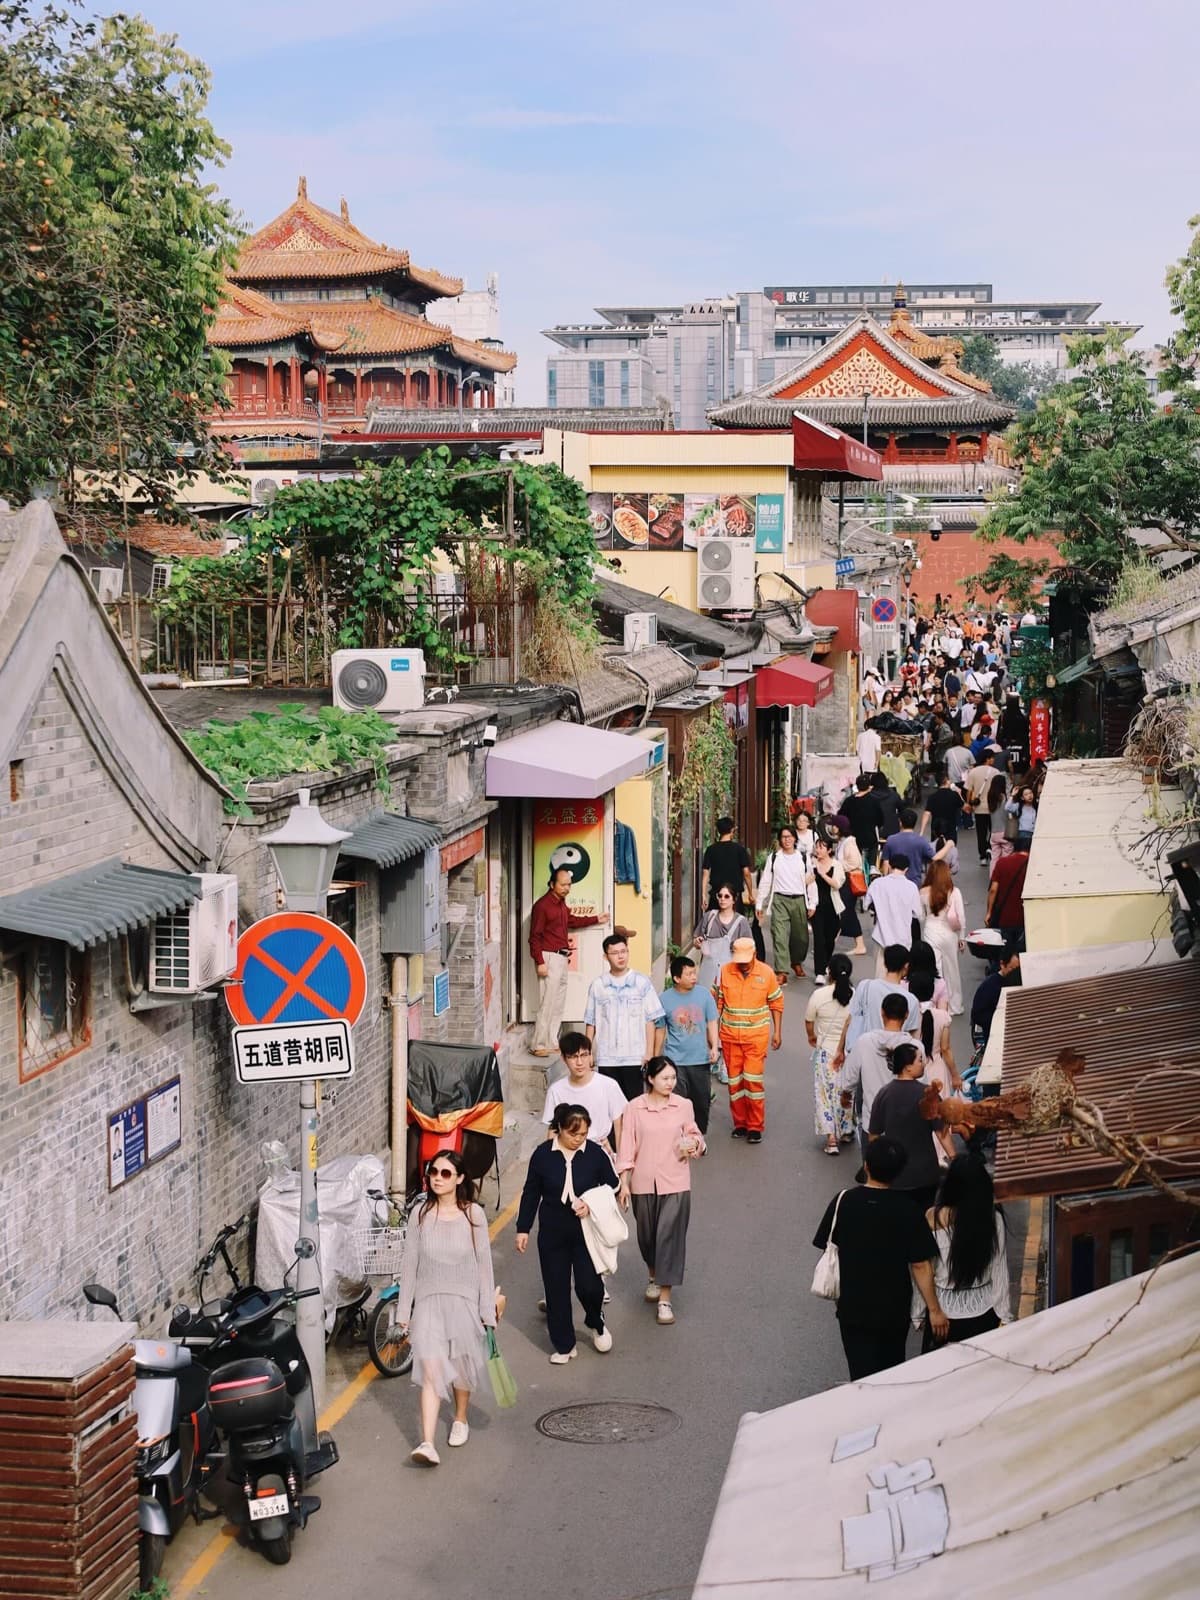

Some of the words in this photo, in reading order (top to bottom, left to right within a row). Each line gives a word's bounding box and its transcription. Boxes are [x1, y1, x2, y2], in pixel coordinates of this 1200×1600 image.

[243, 1035, 344, 1068] 五道营胡同
